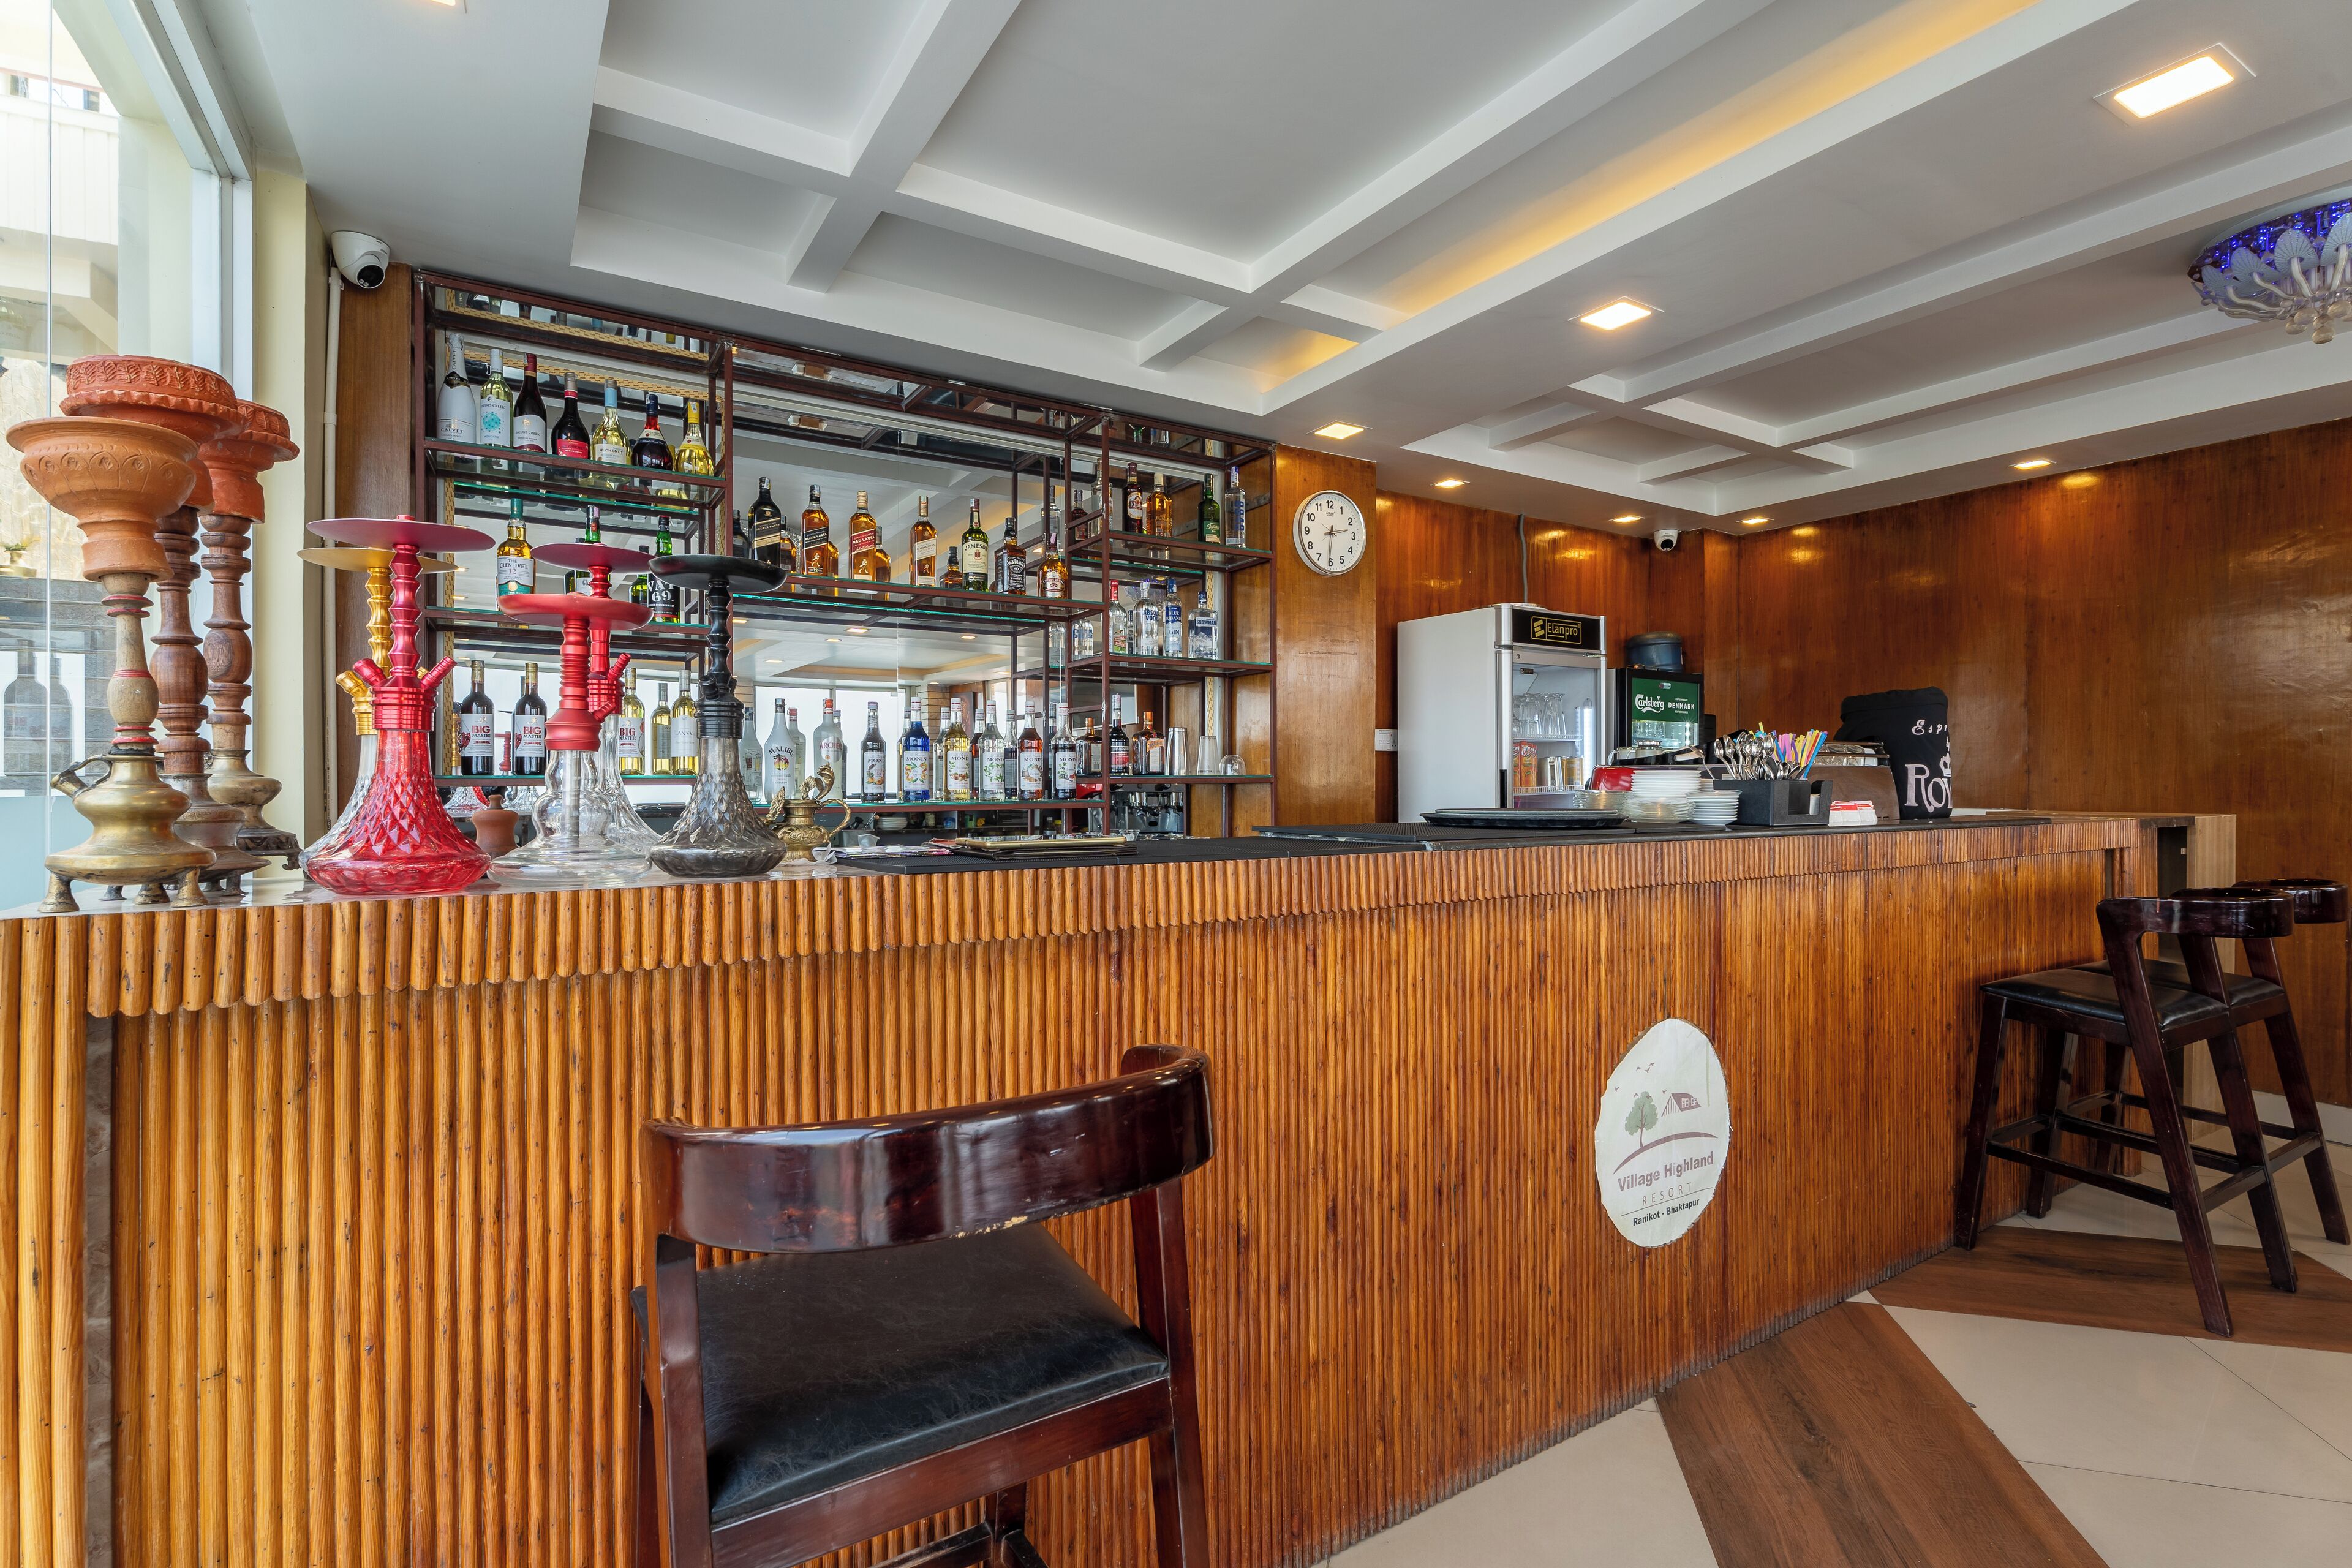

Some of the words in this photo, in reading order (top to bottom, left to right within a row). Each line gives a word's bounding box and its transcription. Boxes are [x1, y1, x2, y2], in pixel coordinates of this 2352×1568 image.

[1315, 503, 1322, 511] 11
[1326, 500, 1334, 509] 12
[1340, 506, 1343, 514] 1
[1306, 513, 1316, 522] 10
[1348, 517, 1353, 526] 2
[1304, 526, 1310, 535] 9
[1308, 541, 1313, 549] 8
[1348, 546, 1353, 554] 4
[1316, 552, 1322, 561] 7
[1328, 557, 1333, 567] 6
[647, 580, 674, 591] VAT
[1547, 623, 1578, 640] Elanpro
[1635, 694, 1665, 712] Carlsberg
[472, 725, 490, 734] BIG
[819, 742, 842, 750] ARCHER
[768, 745, 794, 757] MALIBU
[1618, 1170, 1660, 1191] Village
[1664, 1151, 1714, 1178] Highland
[1642, 1182, 1692, 1206] RESORT
[1633, 1210, 1660, 1226] Ranikot
[1666, 1199, 1700, 1216] Bhaktapur
